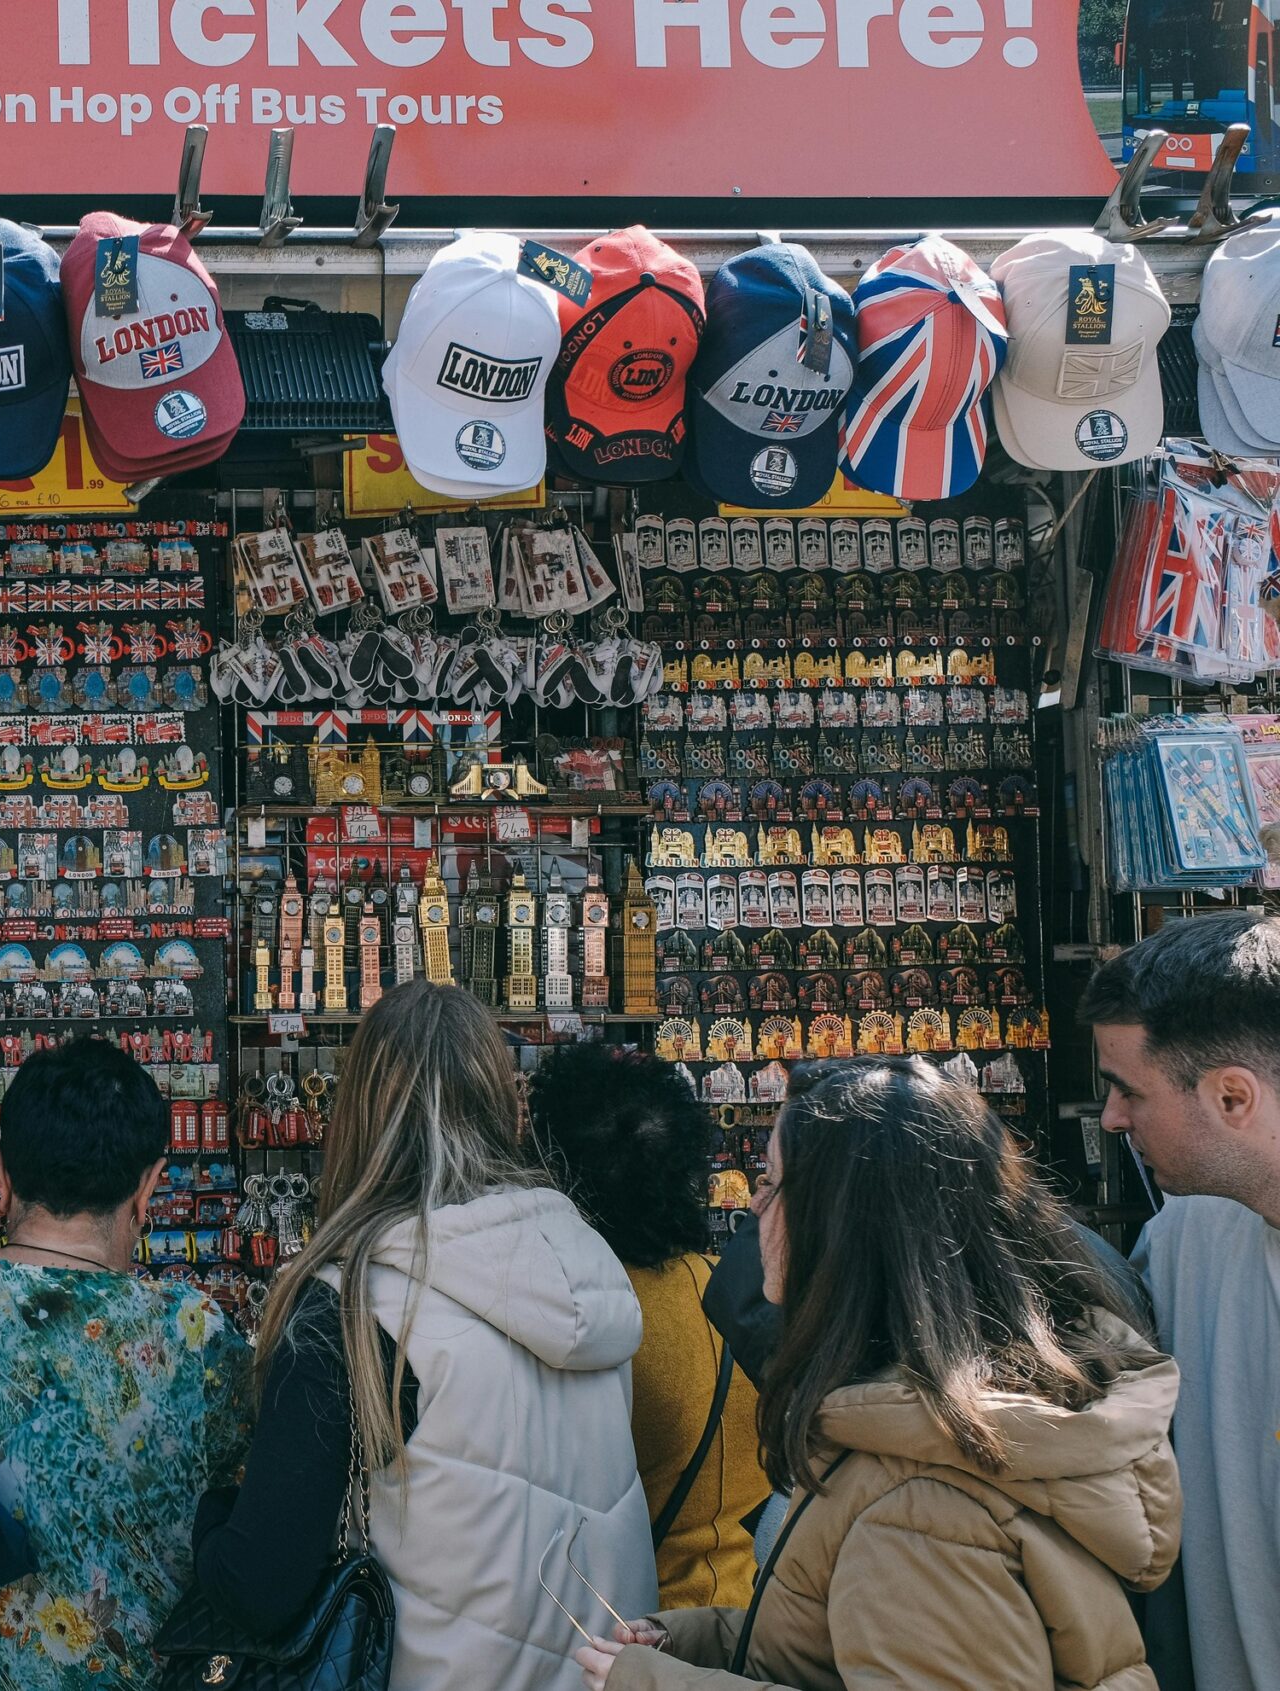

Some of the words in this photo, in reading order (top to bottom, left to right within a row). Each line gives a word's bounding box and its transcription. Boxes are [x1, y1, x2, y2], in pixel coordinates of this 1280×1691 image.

[636, 0, 1039, 68] Here!
[50, 87, 153, 136] Hop
[163, 83, 242, 125] Off
[262, 88, 346, 125] Bus
[357, 87, 504, 125] Tours
[100, 292, 131, 302] STALLION
[1072, 322, 1107, 330] STALLION
[94, 305, 211, 365] LONDON
[560, 312, 606, 369] LONDON
[444, 352, 537, 397] LONDON
[623, 367, 661, 386] LDN
[729, 381, 845, 413] LONDON
[165, 418, 182, 431] ROYAL
[181, 408, 204, 423] STALLION
[566, 423, 594, 450] LDN
[1100, 437, 1122, 445] STALLION
[461, 445, 478, 453] ROYAL
[478, 448, 500, 458] STALLION
[755, 471, 772, 479] ROYAL
[772, 474, 793, 484] STALLION
[0, 493, 10, 507] 6
[37, 493, 61, 506] £10
[442, 714, 481, 722] LONDON
[346, 806, 373, 815] SALE
[495, 805, 523, 813] SALE
[271, 1018, 300, 1033] £9.99
